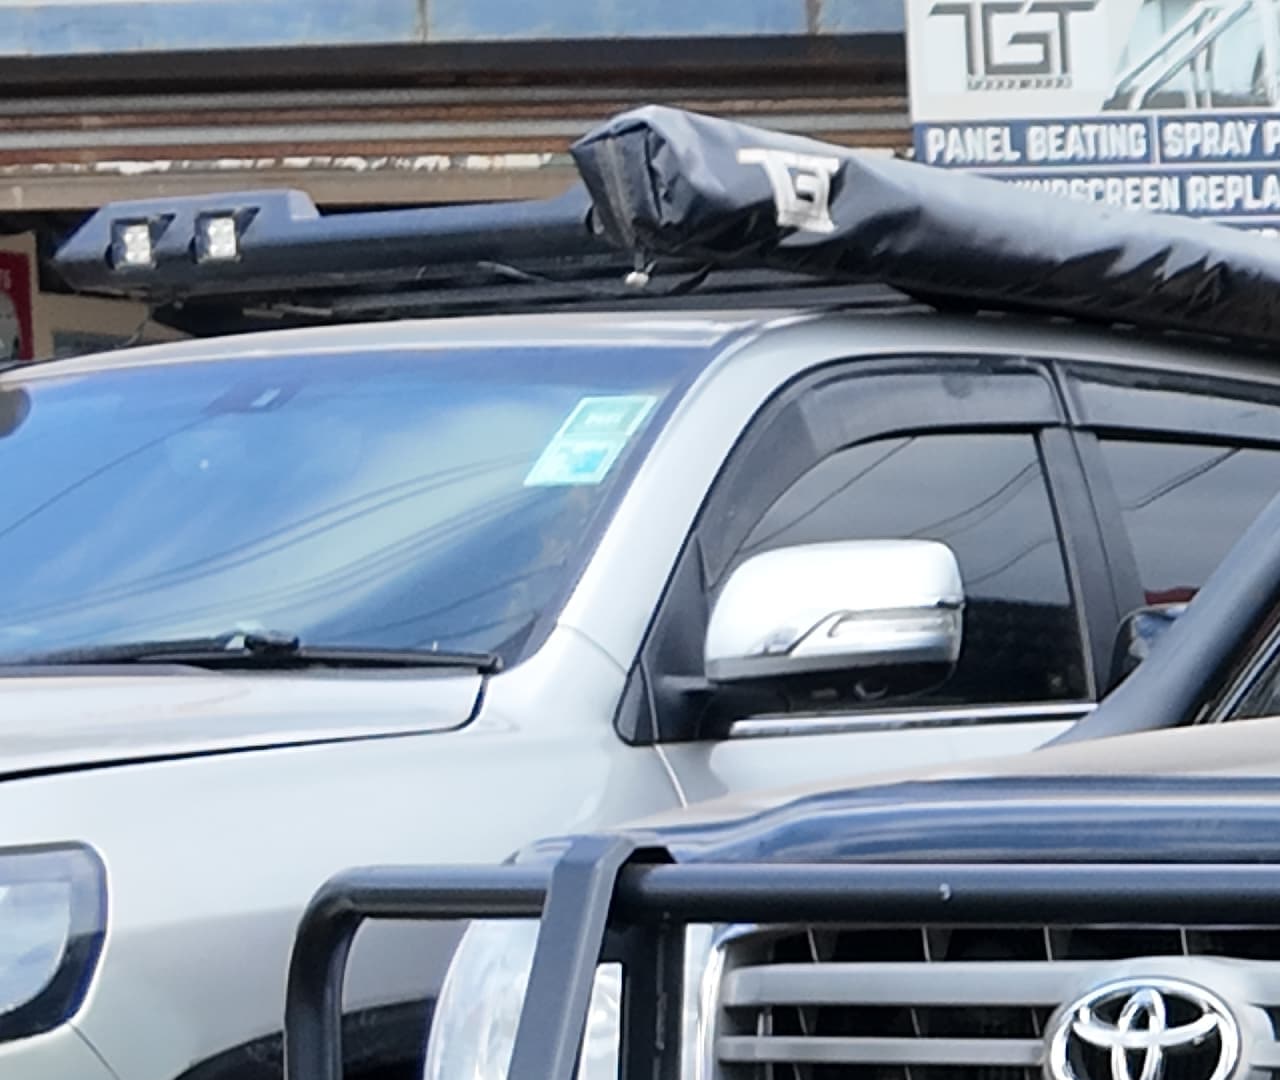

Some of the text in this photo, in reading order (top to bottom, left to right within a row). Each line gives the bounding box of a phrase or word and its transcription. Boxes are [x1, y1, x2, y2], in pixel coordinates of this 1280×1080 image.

[926, 126, 1021, 163] PANEL
[1026, 122, 1147, 161] BEATING
[1162, 119, 1257, 158] SPRAY
[1008, 176, 1180, 212] SCREEN
